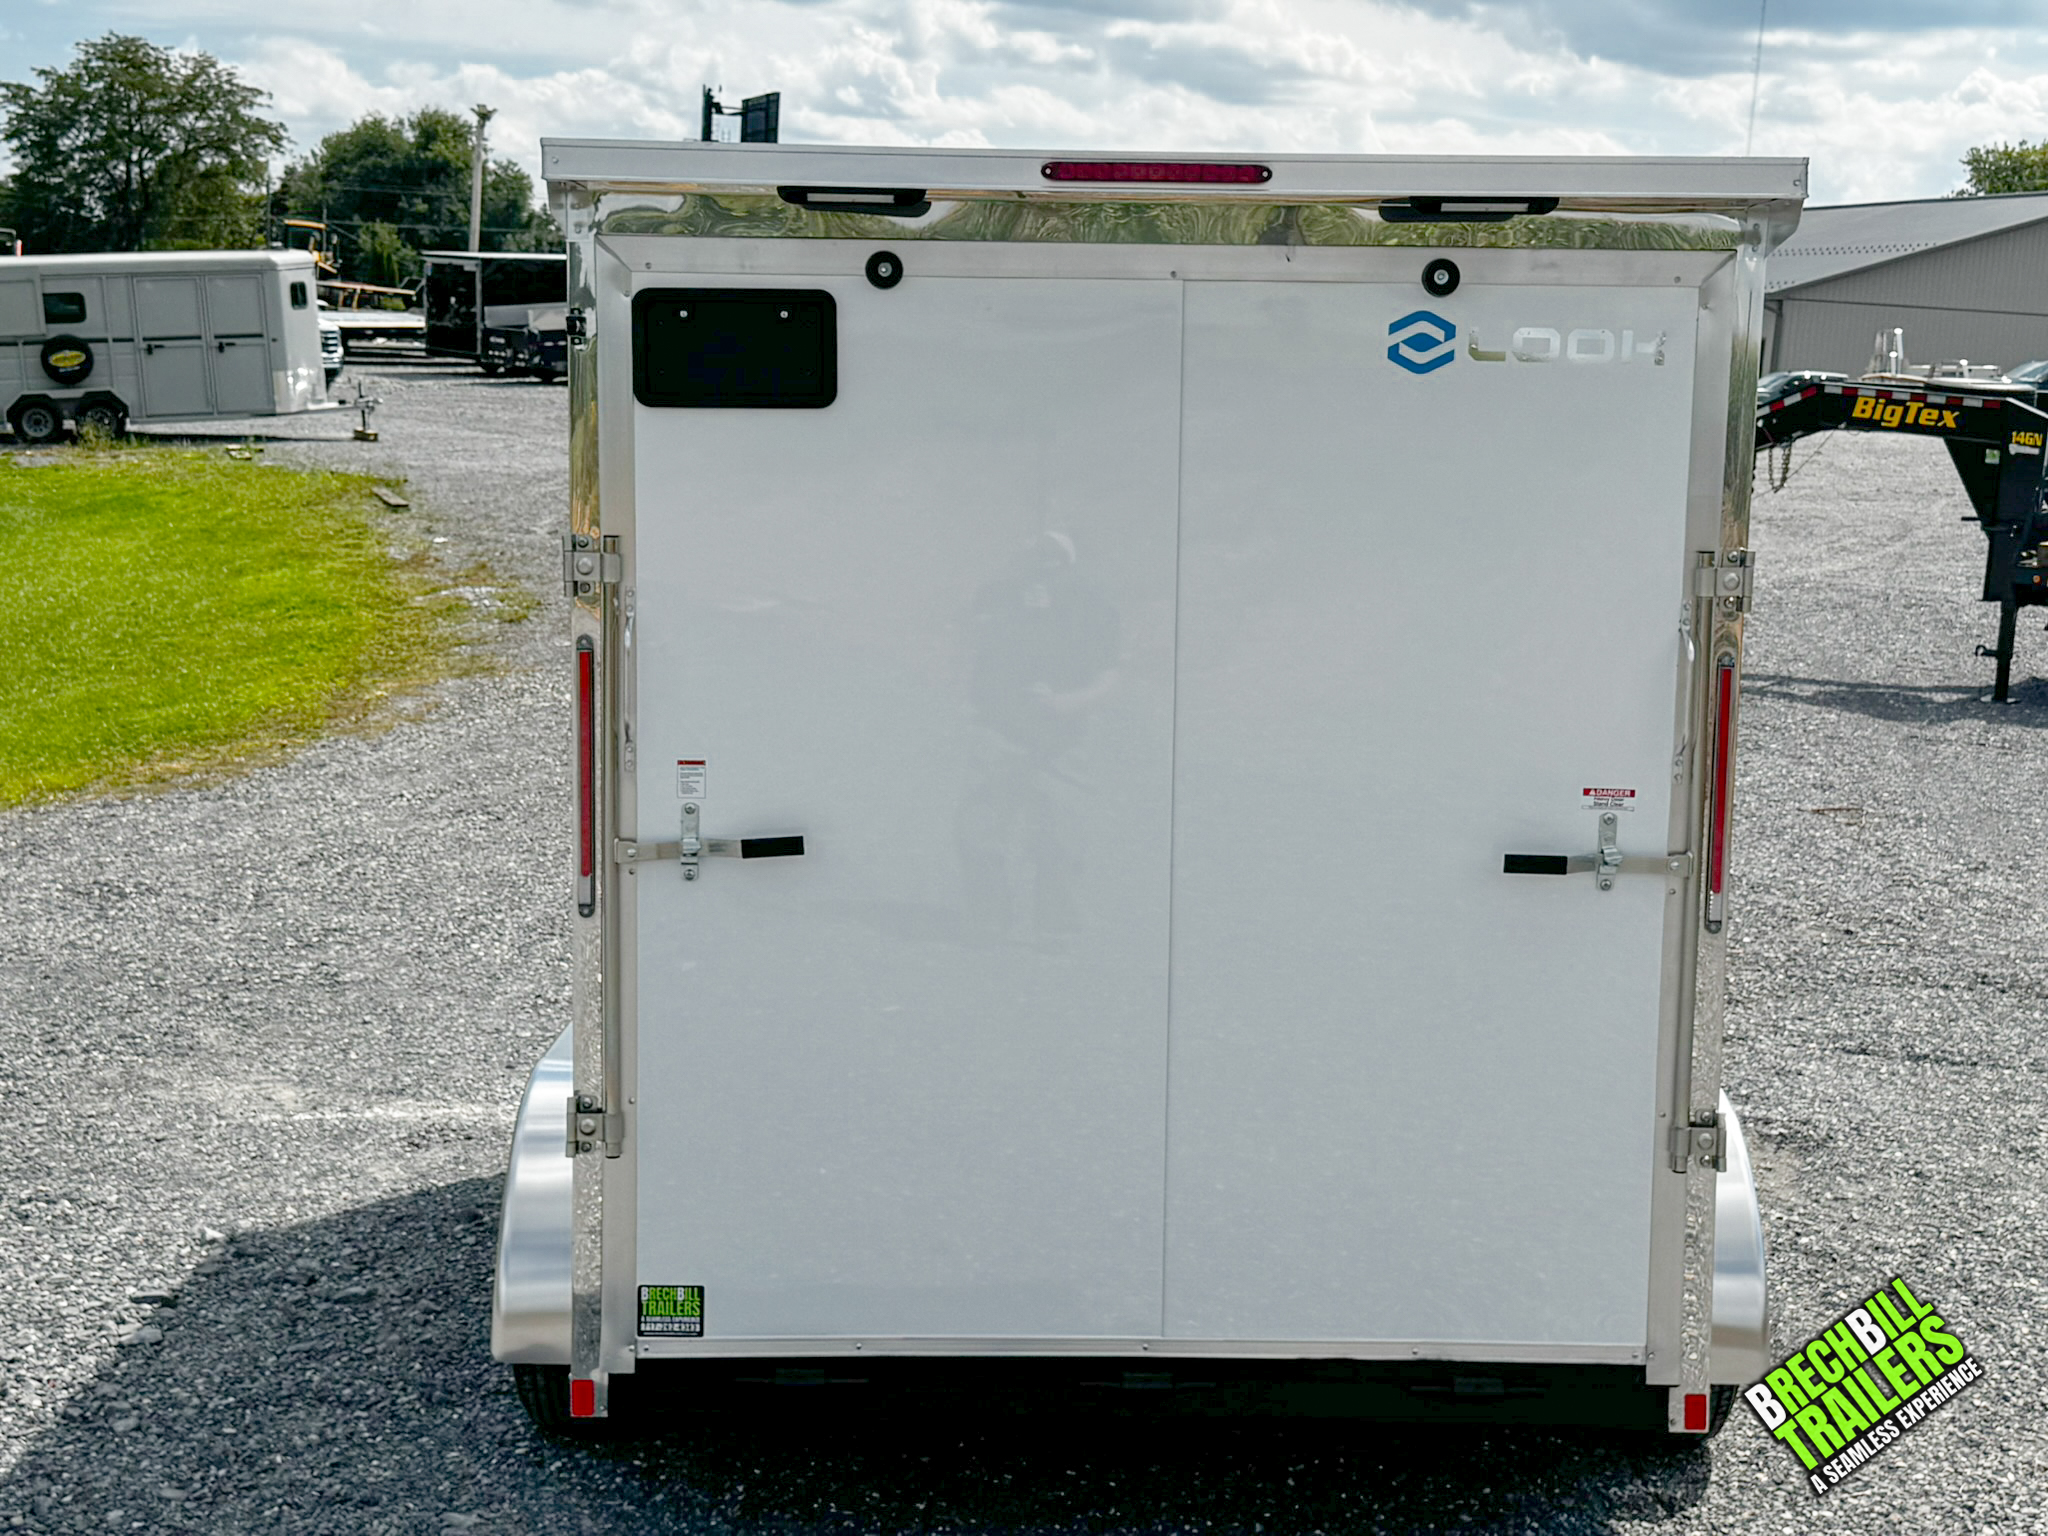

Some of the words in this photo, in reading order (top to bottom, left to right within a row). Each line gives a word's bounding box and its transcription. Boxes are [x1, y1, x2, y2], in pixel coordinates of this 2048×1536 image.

[1468, 327, 1667, 366] LOOK
[1596, 789, 1631, 798] DANGER
[641, 1287, 700, 1301] BRECHBILL
[641, 1301, 701, 1315] TRAILERS
